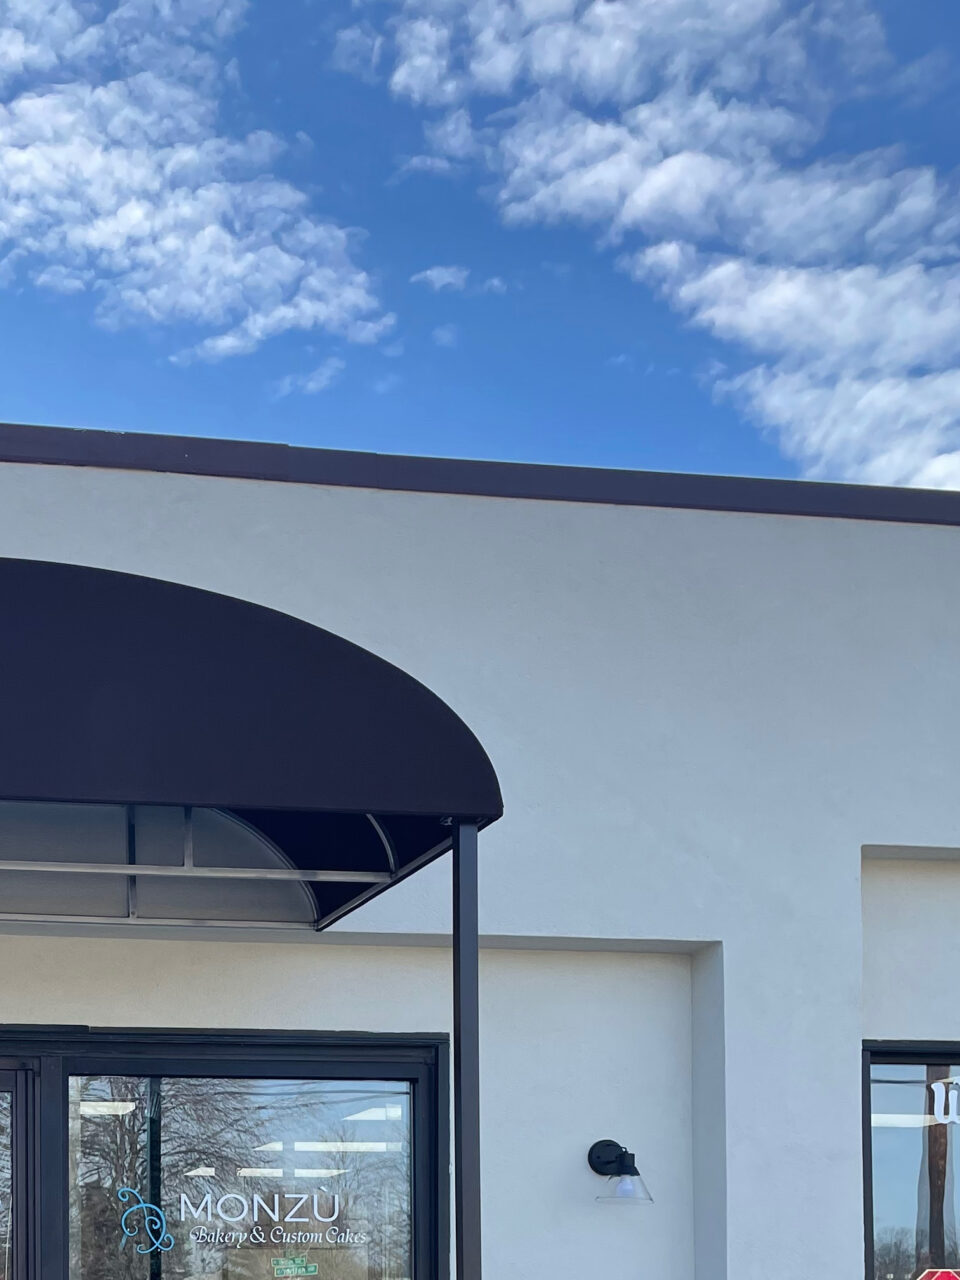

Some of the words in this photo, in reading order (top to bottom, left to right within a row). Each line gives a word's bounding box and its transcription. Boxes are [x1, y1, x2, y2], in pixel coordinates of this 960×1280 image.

[180, 1185, 340, 1223] MONZÙ
[189, 1225, 248, 1249] Bakery
[249, 1226, 267, 1244] &
[269, 1227, 323, 1244] Custom
[325, 1226, 367, 1244] Cakes
